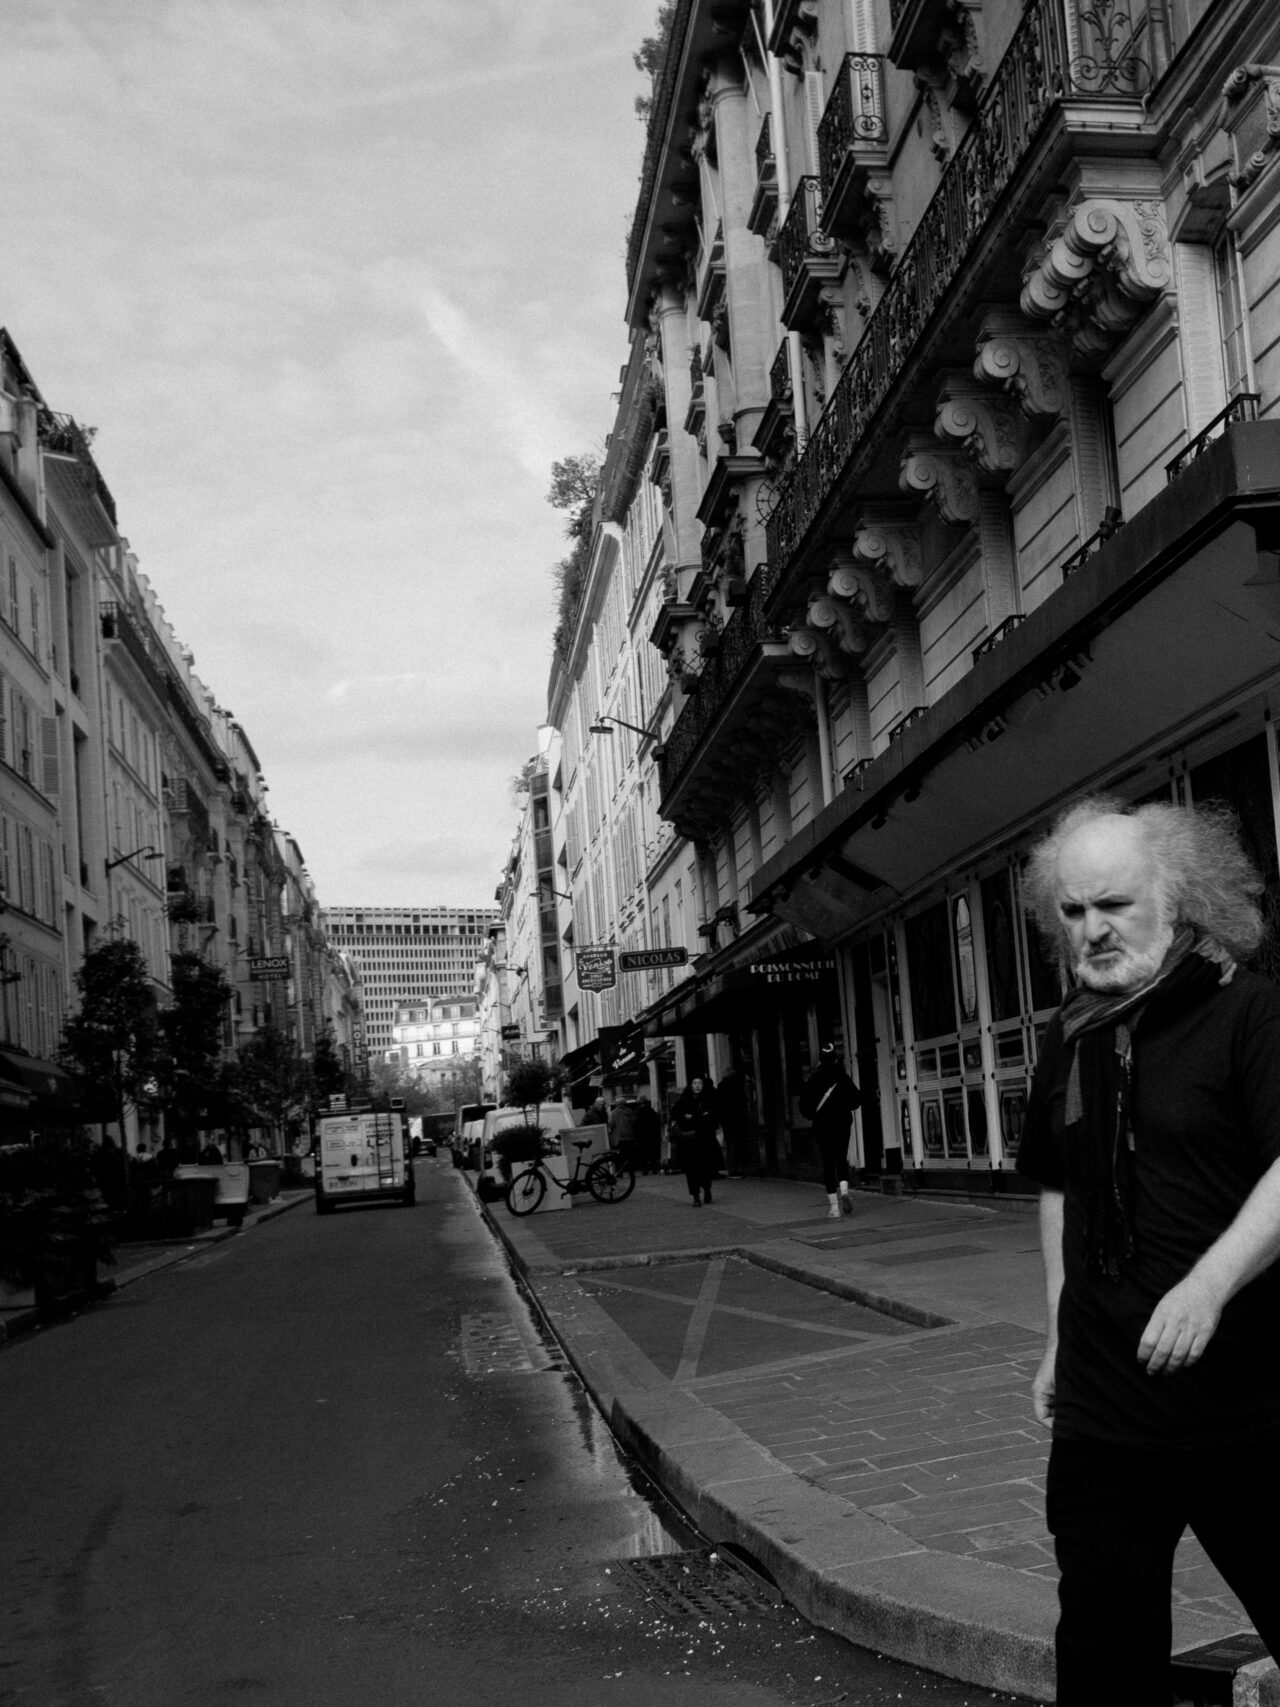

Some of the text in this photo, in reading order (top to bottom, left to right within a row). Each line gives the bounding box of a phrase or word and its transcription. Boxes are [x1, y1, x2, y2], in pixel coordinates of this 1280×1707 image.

[251, 958, 287, 969] LENOX
[627, 950, 681, 967] NICOLAS
[749, 960, 835, 974] POISSONNERIE
[353, 1023, 362, 1064] HOTEL
